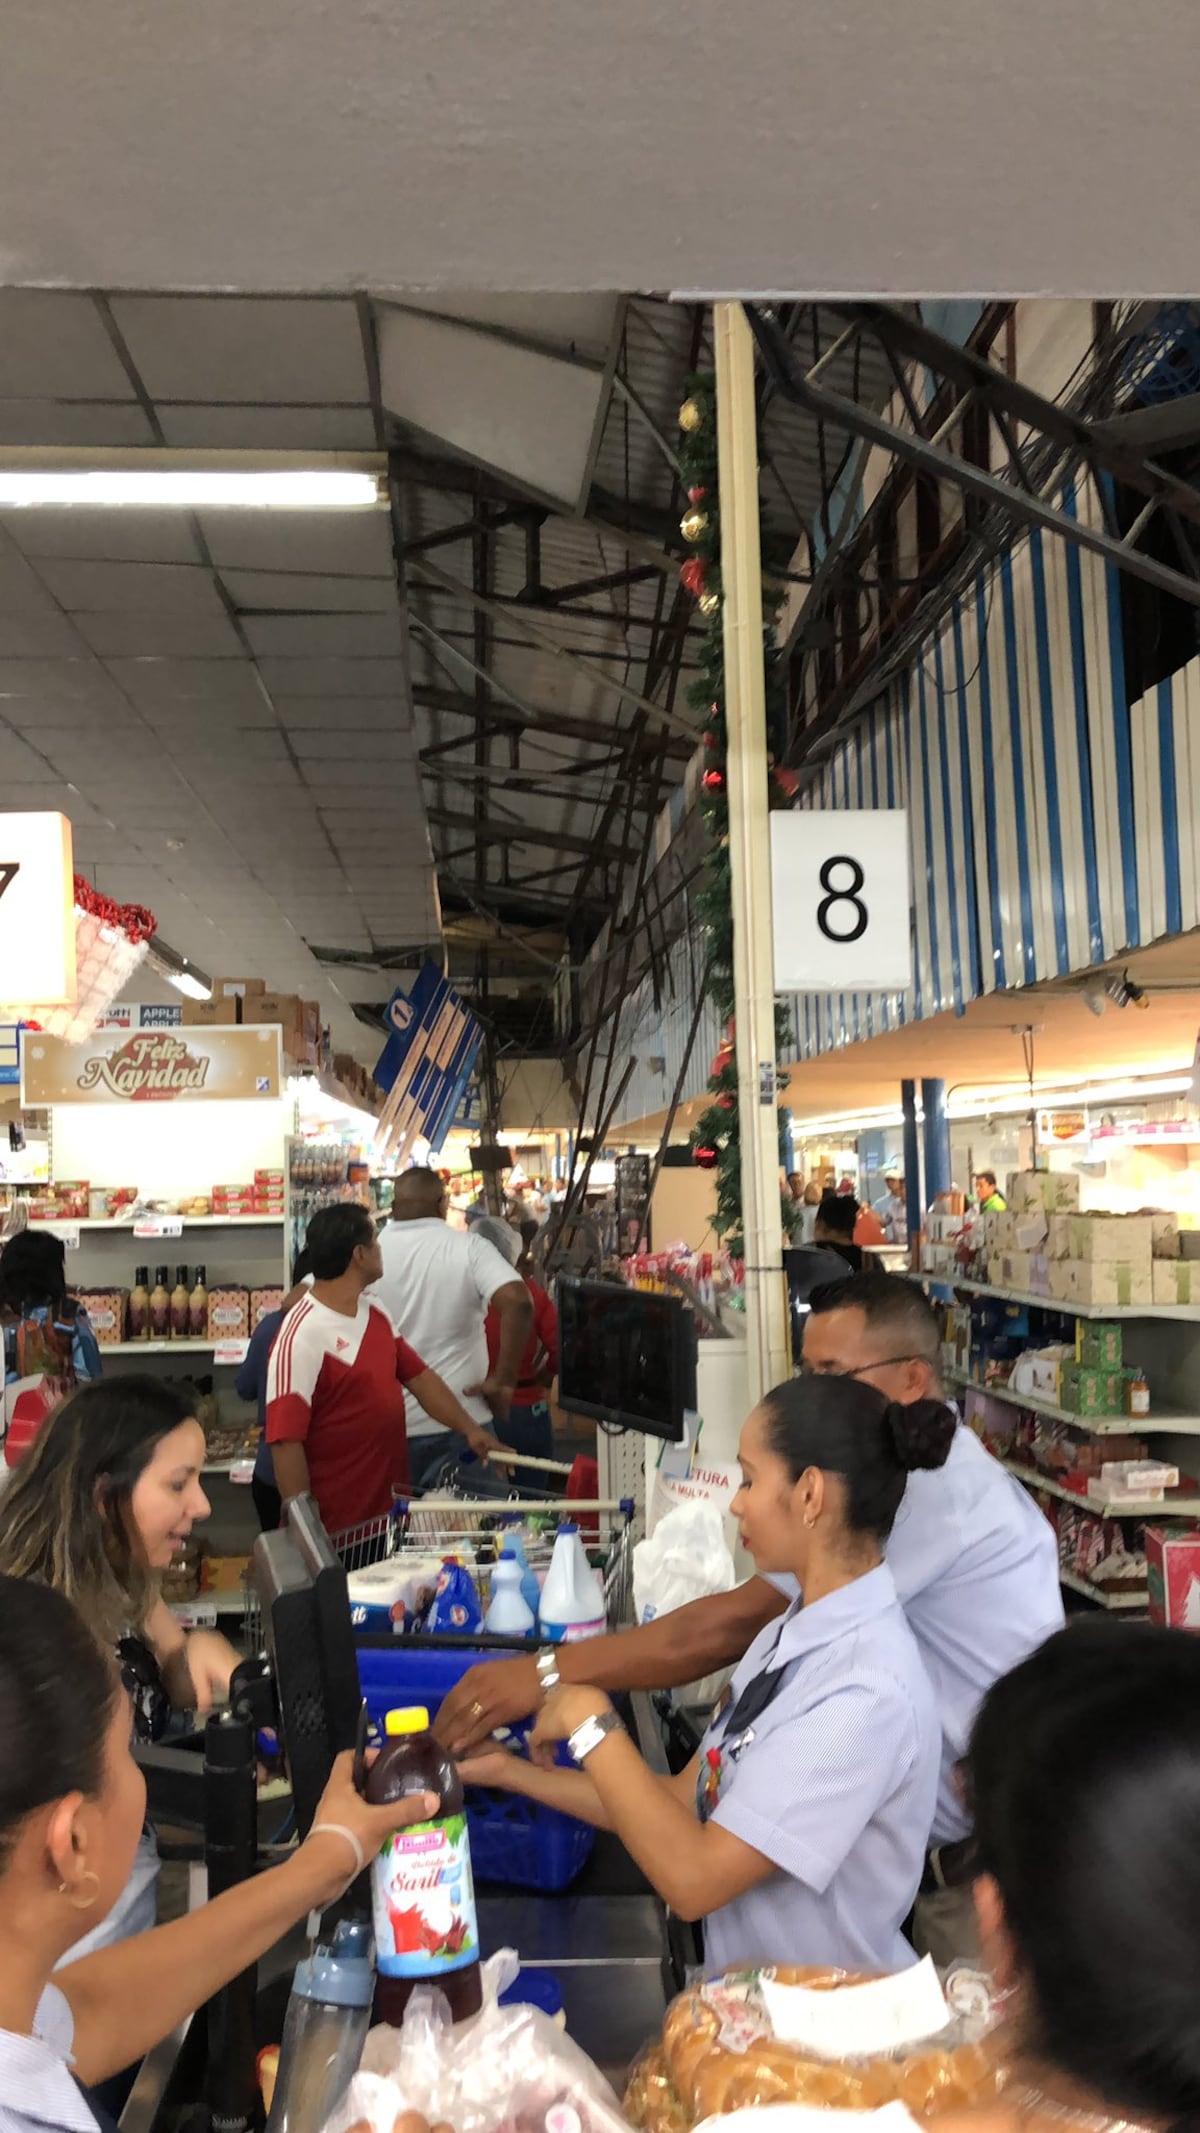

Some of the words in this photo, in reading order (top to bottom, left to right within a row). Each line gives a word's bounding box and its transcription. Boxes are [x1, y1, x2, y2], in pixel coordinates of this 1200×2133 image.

[817, 855, 868, 942] 8
[132, 1037, 187, 1066] Feliz
[78, 1056, 210, 1097] Navidad
[390, 1866, 442, 1891] Saril
